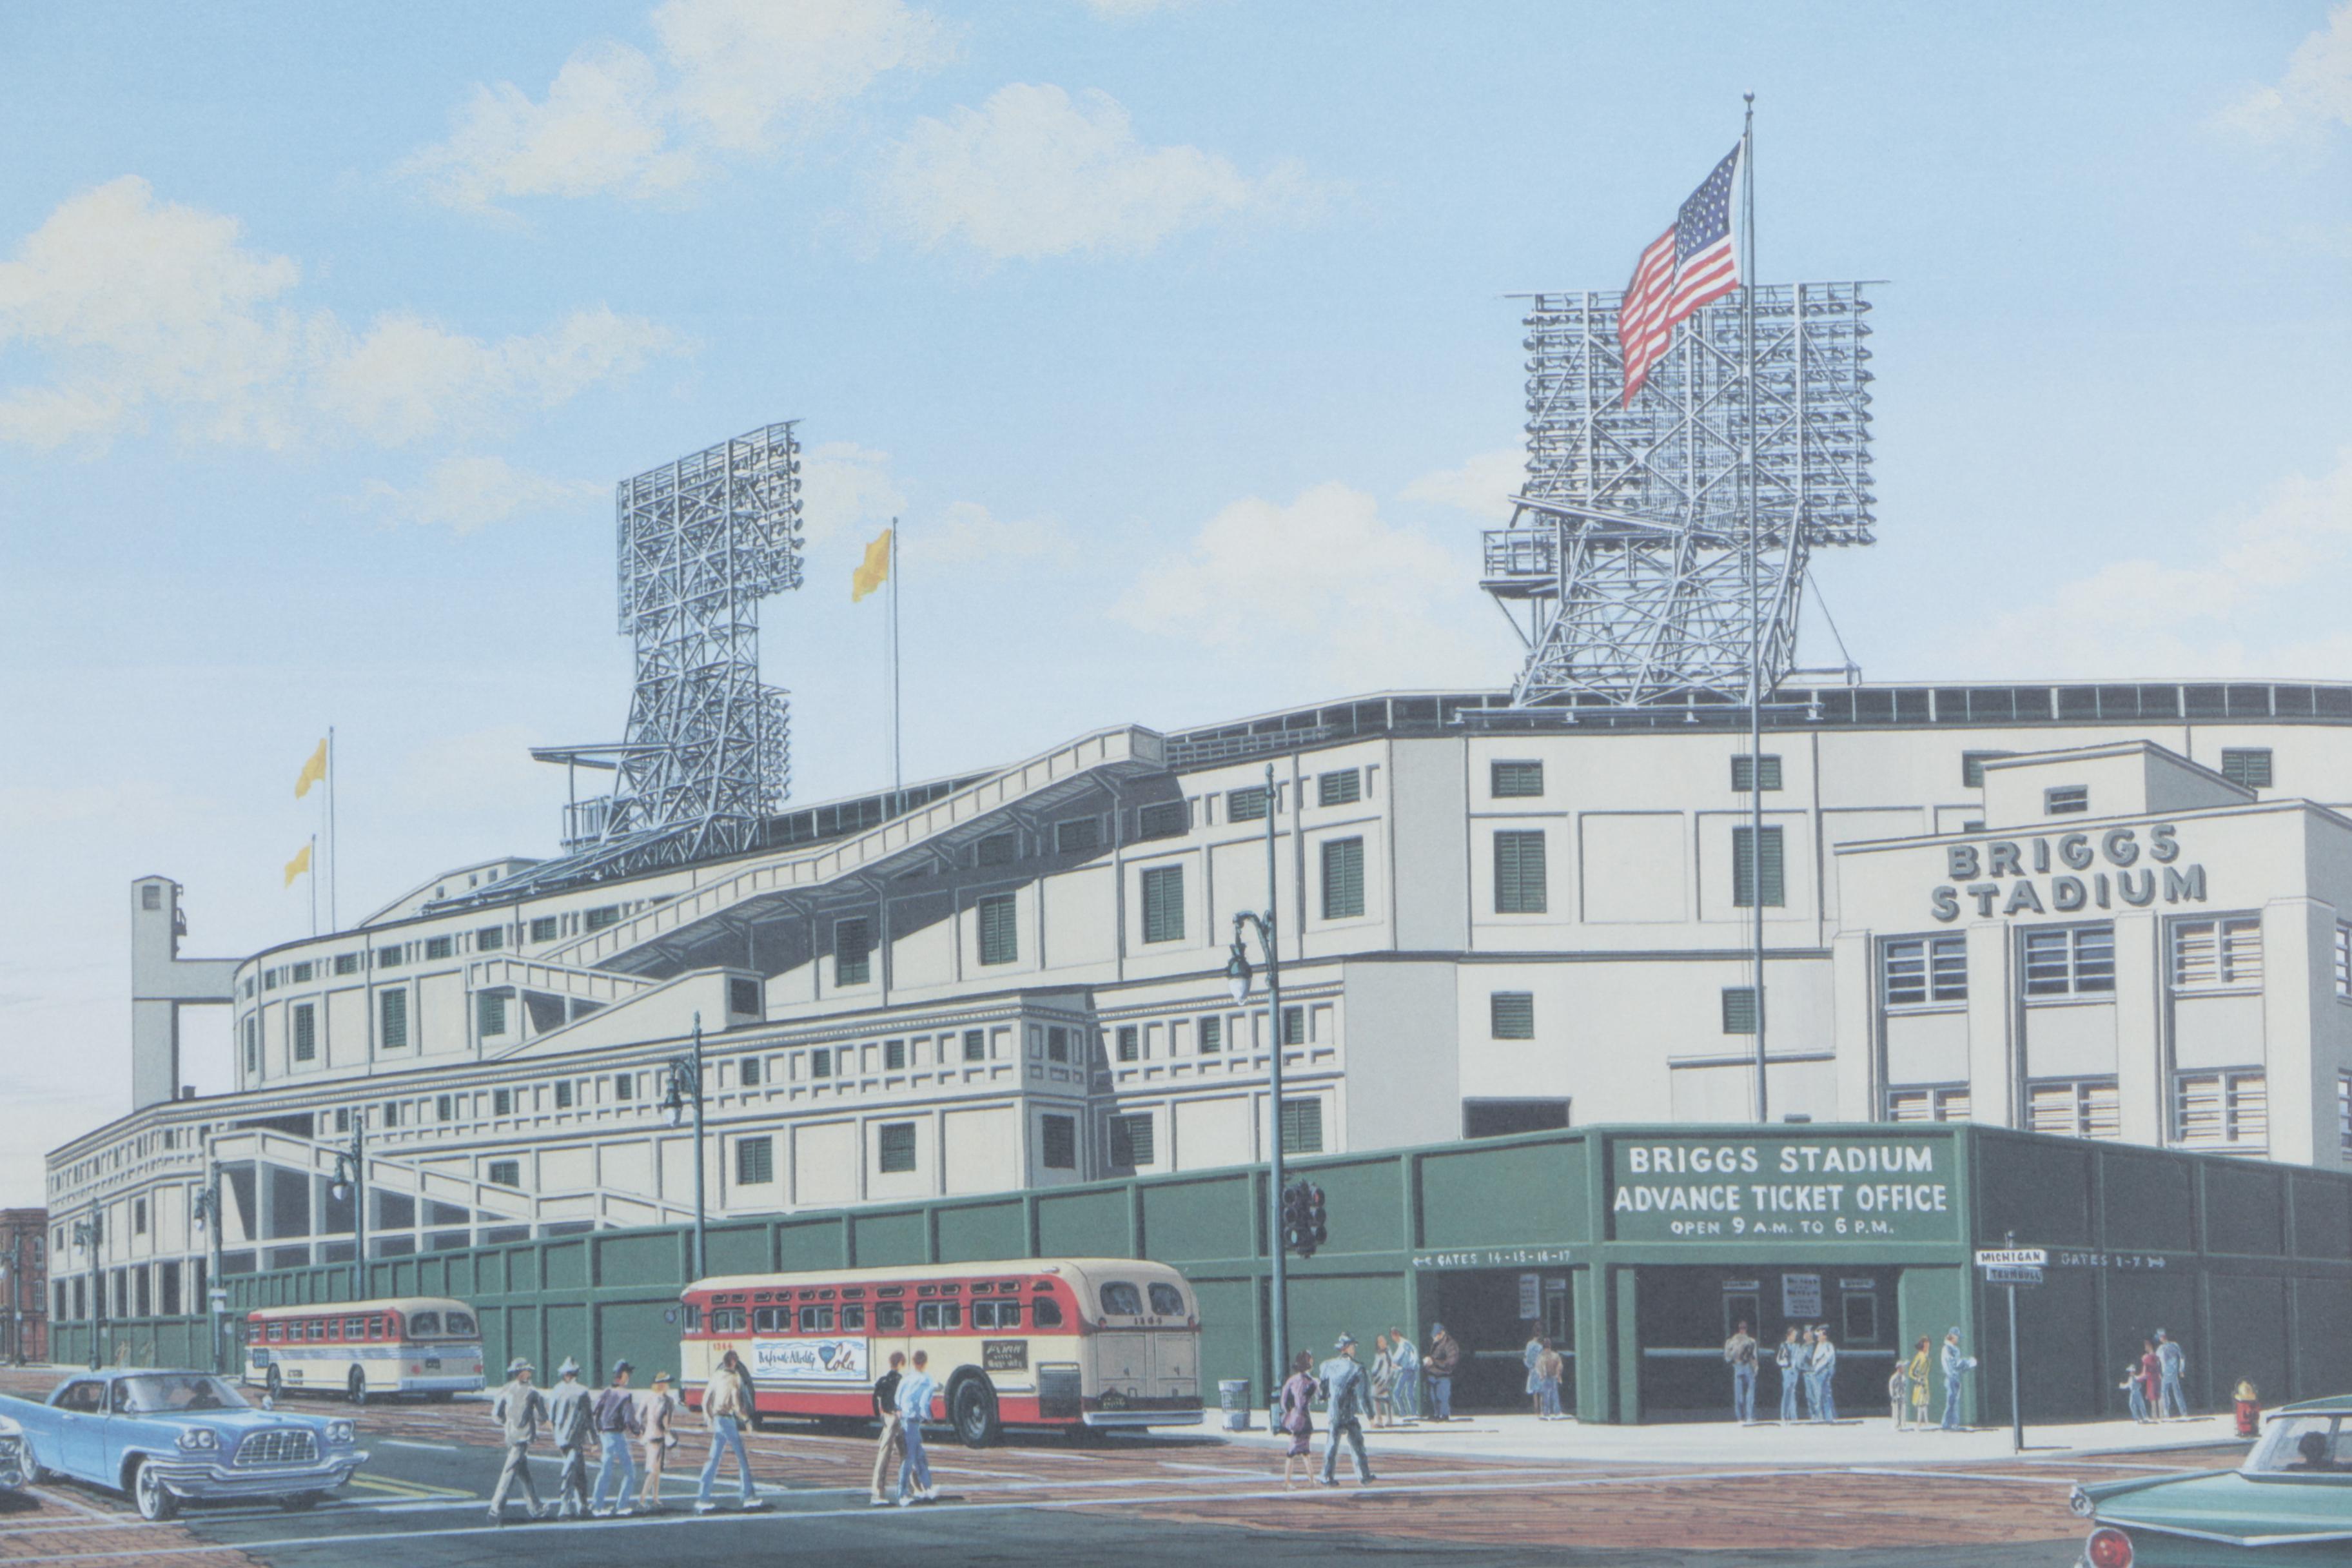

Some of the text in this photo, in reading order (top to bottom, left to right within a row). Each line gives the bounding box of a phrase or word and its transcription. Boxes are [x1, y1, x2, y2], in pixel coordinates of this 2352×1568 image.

[1947, 824, 2180, 881] BRIGGS
[1931, 863, 2207, 923] STADIUM
[1629, 1146, 1933, 1173] BRIGGS STADIUM
[1614, 1184, 1947, 1211] ADVANCE TICKET OFFICE
[1671, 1217, 1894, 1234] OPEN 9 A.M. TO 6 P.M.
[1437, 1253, 1477, 1266] GATES
[1981, 1251, 2041, 1262] MICHIGAN
[2061, 1253, 2107, 1266] GATES
[824, 1342, 856, 1371] Cola
